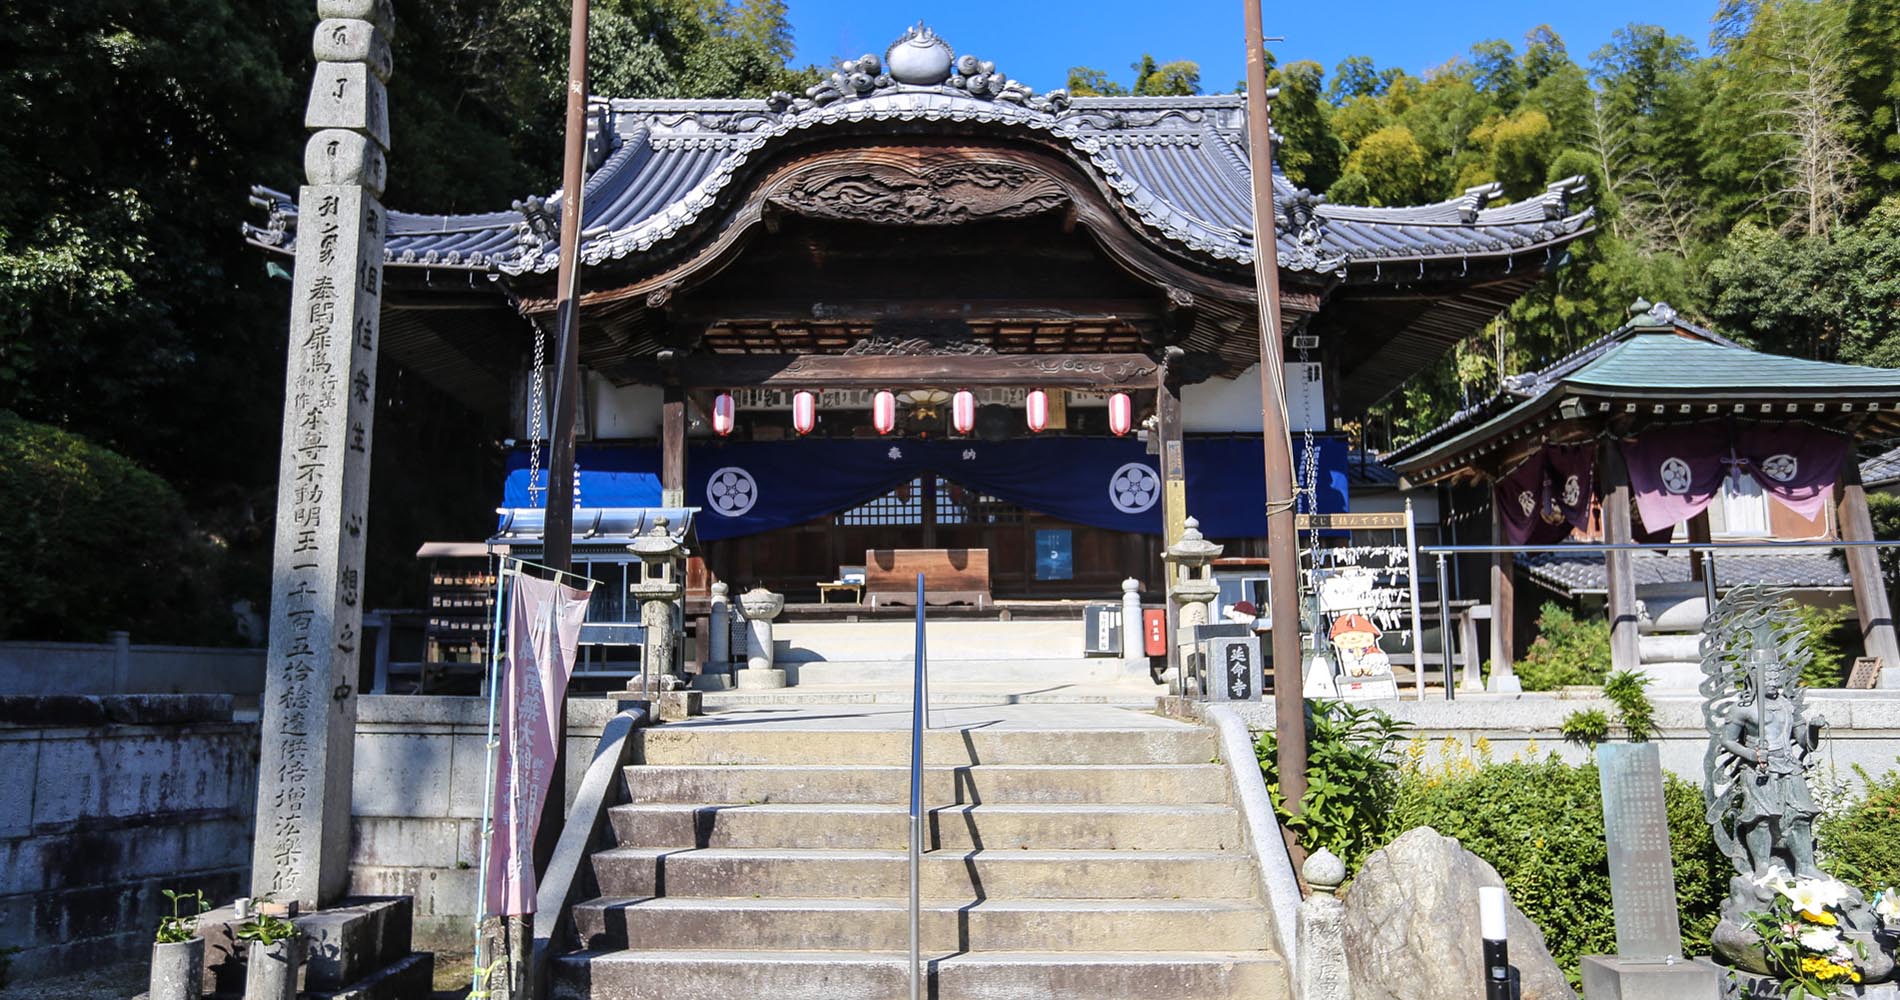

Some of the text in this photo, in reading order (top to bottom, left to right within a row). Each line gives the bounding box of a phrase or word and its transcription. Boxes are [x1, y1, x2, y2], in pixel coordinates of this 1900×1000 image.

[888, 446, 976, 460] 奉 納
[1230, 646, 1248, 697] 延命寺
